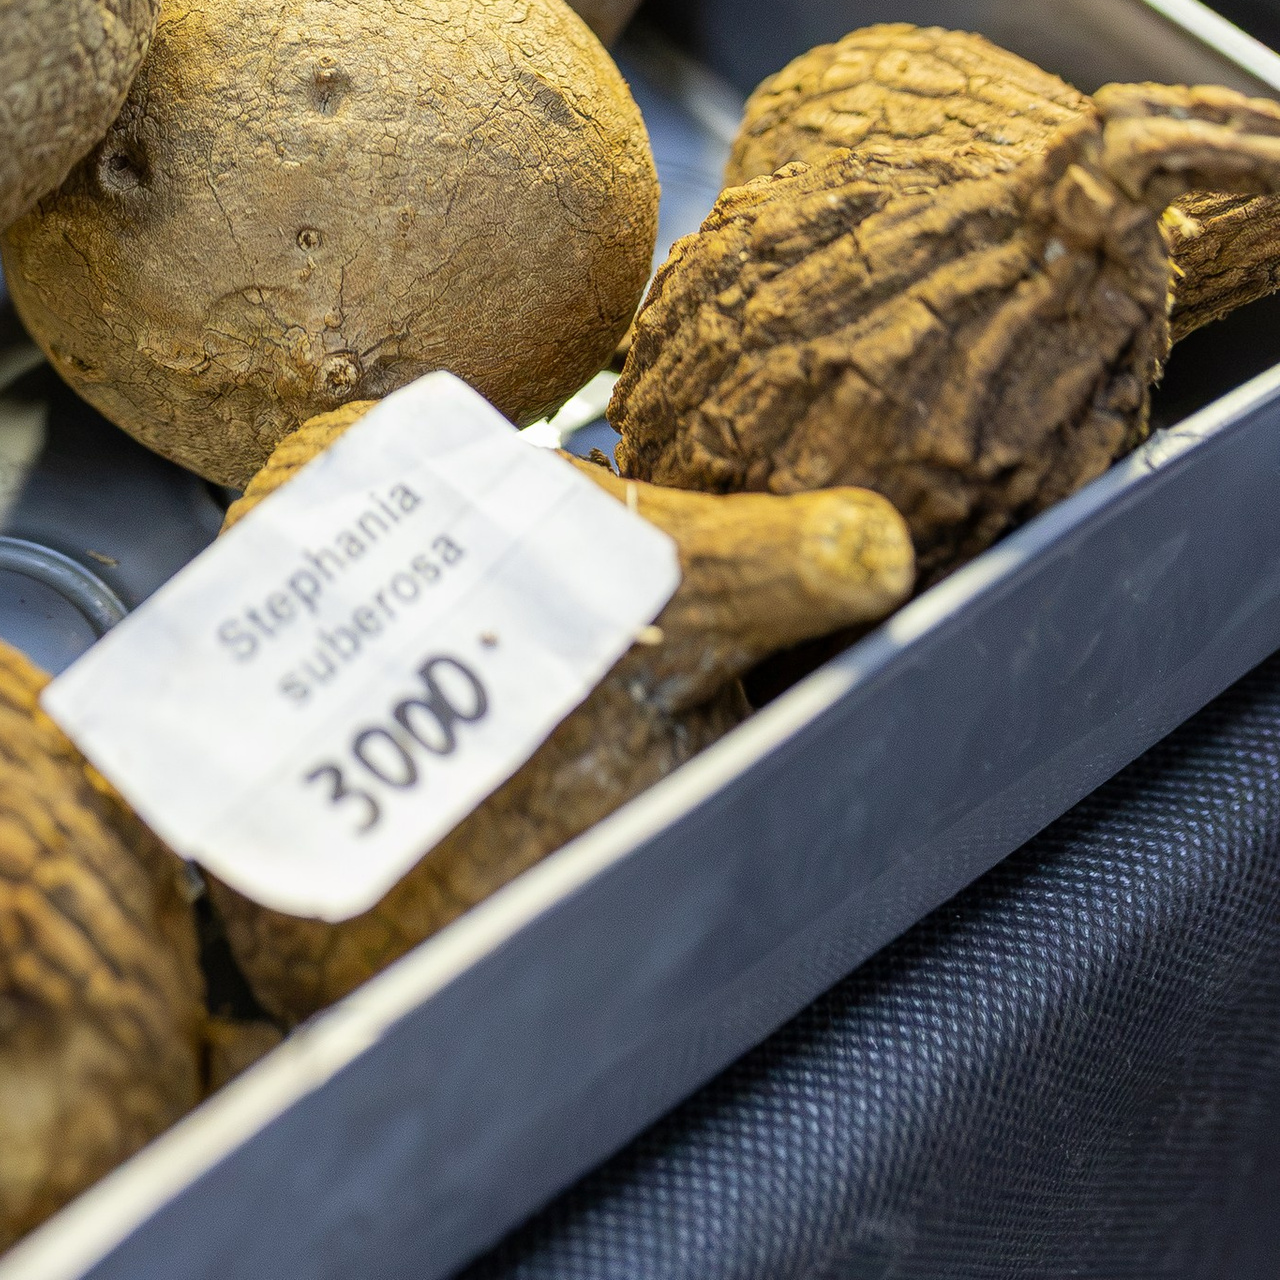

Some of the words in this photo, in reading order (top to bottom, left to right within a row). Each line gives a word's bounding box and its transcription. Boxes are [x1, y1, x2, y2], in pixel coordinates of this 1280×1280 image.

[219, 481, 421, 662] Stephania
[278, 533, 465, 702] suberosa
[304, 656, 488, 834] 3000
